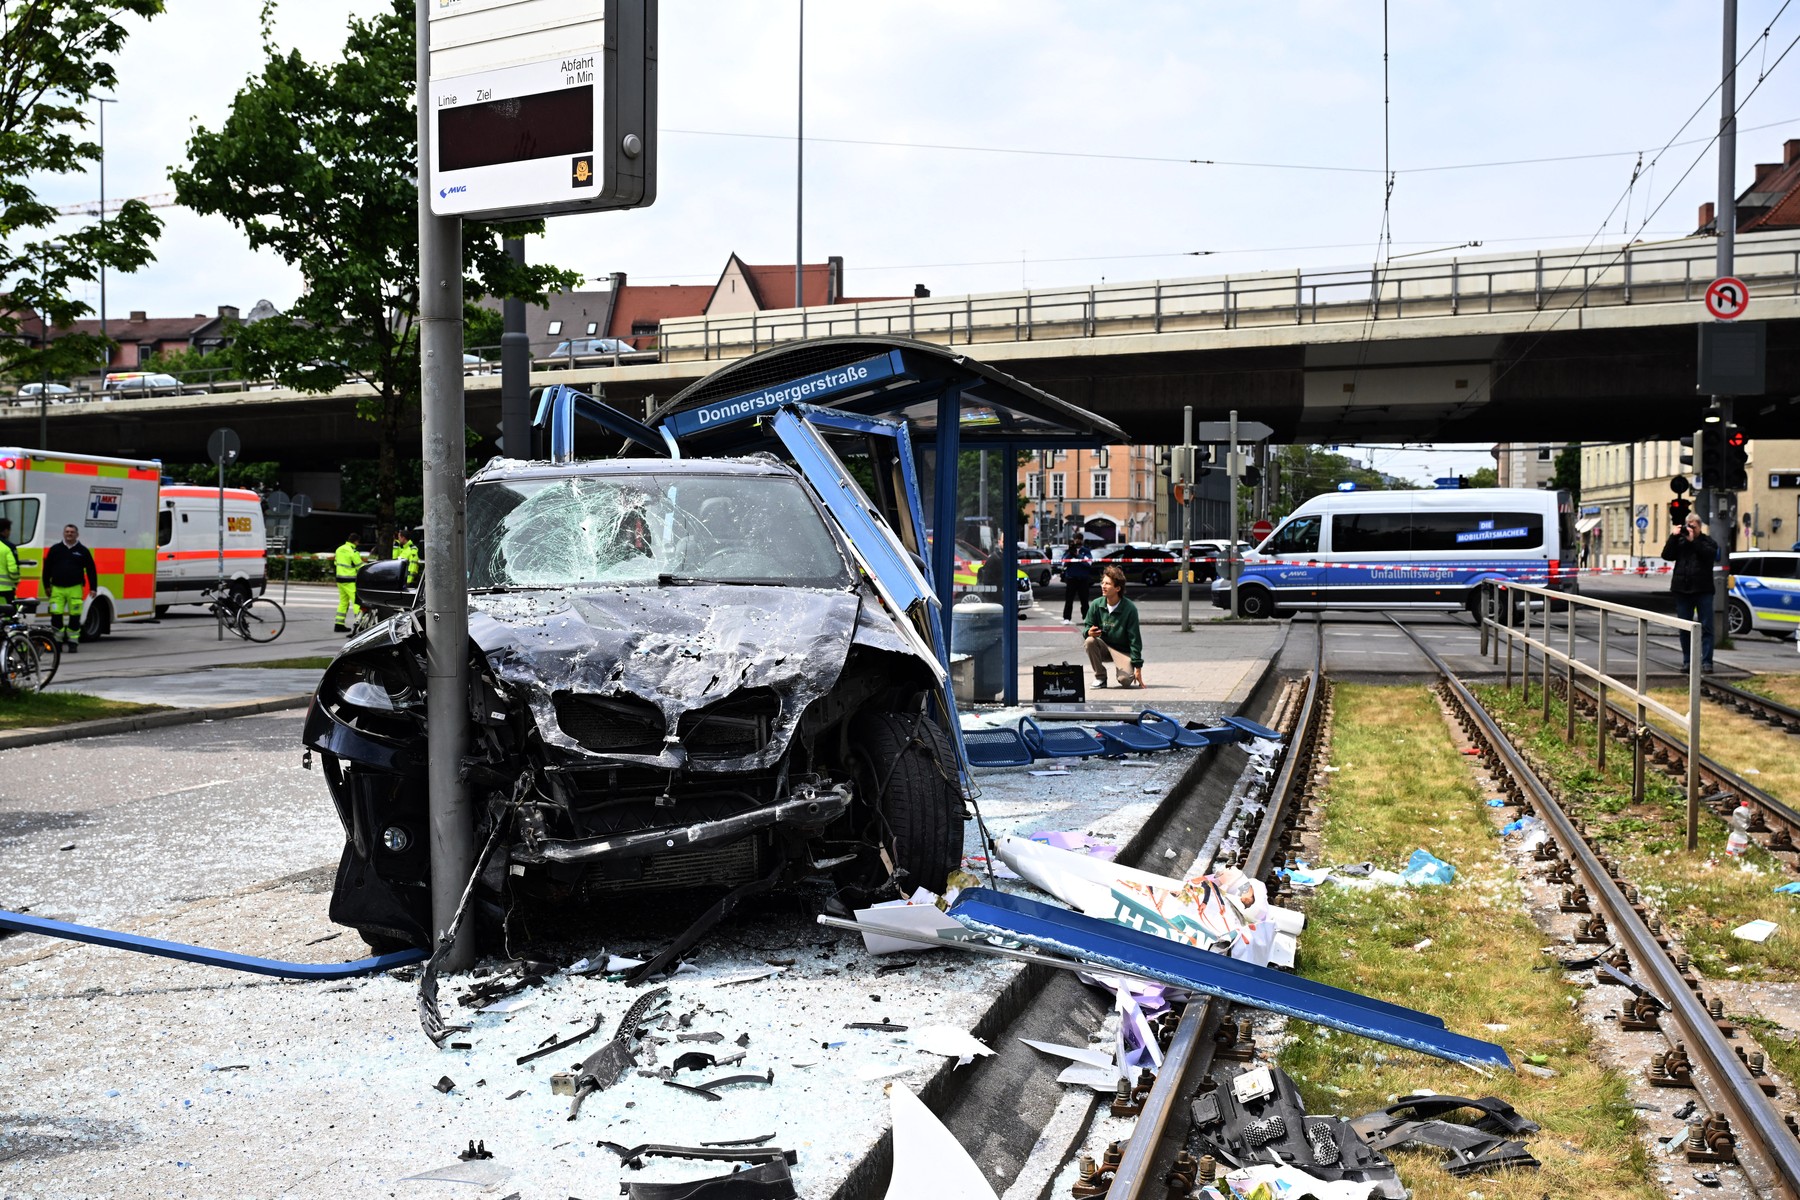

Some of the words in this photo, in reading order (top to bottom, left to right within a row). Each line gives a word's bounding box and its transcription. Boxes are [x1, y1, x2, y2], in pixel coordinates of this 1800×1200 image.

[560, 56, 594, 73] Abfahrt
[566, 74, 575, 85] in
[577, 70, 594, 83] Min
[438, 94, 457, 107] Linie
[476, 88, 492, 101] Ziel
[448, 185, 467, 194] MVG
[697, 365, 868, 425] Donnersbergerstraße
[1480, 521, 1492, 530] DIE
[1370, 568, 1454, 581] Unfallhilfswagen
